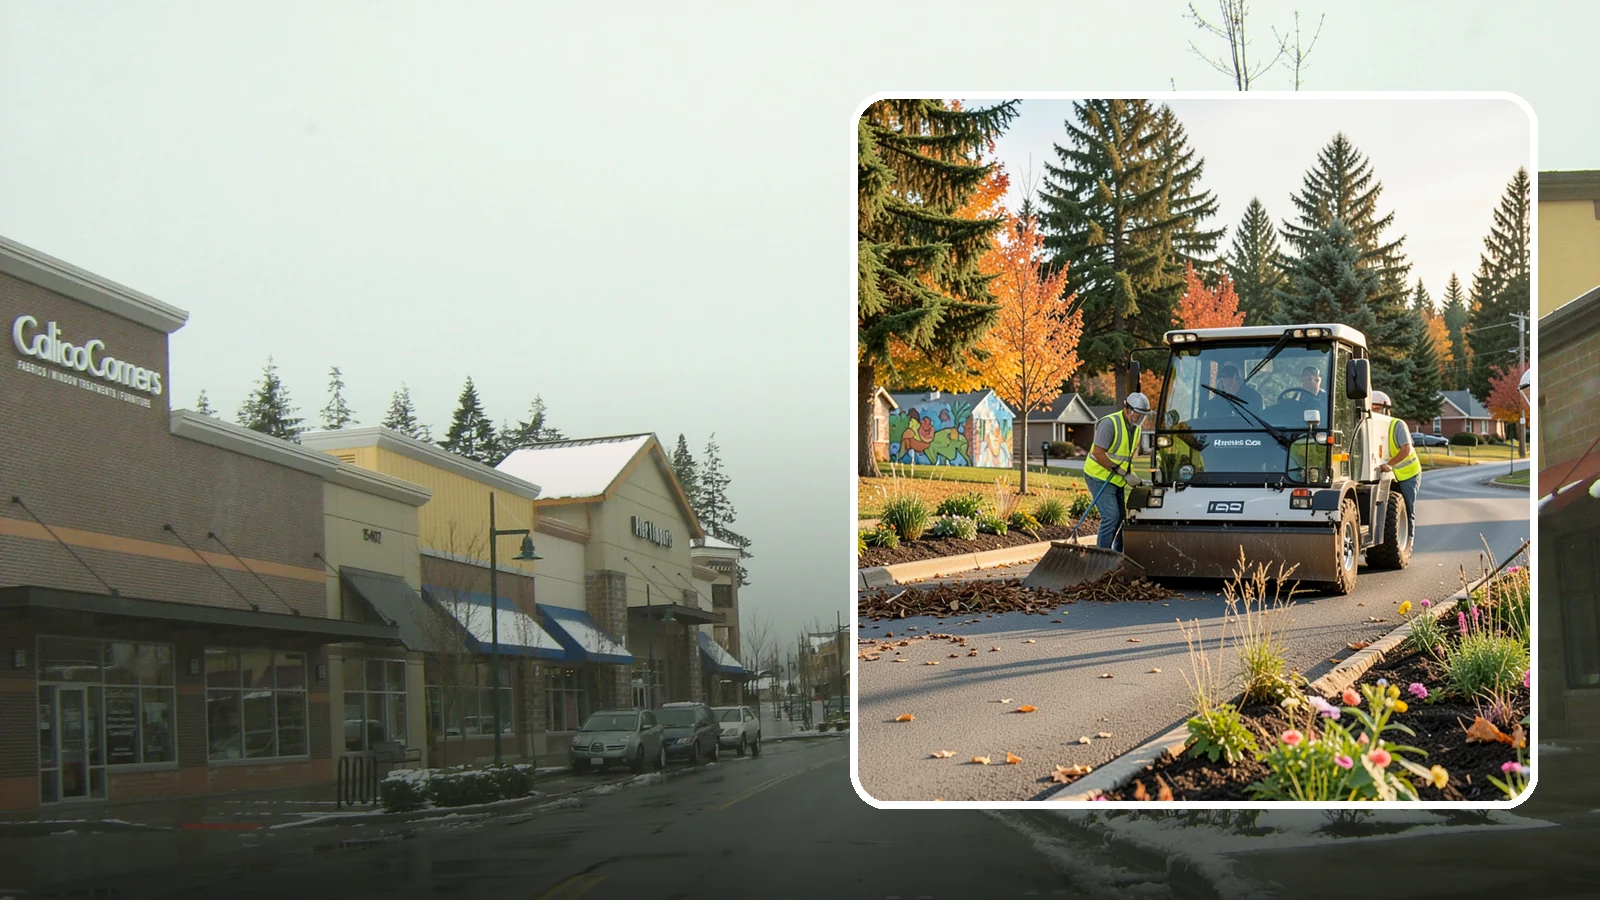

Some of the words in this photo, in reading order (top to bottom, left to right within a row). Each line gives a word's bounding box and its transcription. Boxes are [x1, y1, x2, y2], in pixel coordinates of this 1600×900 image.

[16, 359, 47, 378] FABRICS
[51, 369, 78, 387] WINDOW
[78, 378, 117, 399] TREATMENTS
[120, 390, 152, 409] FURNITURE
